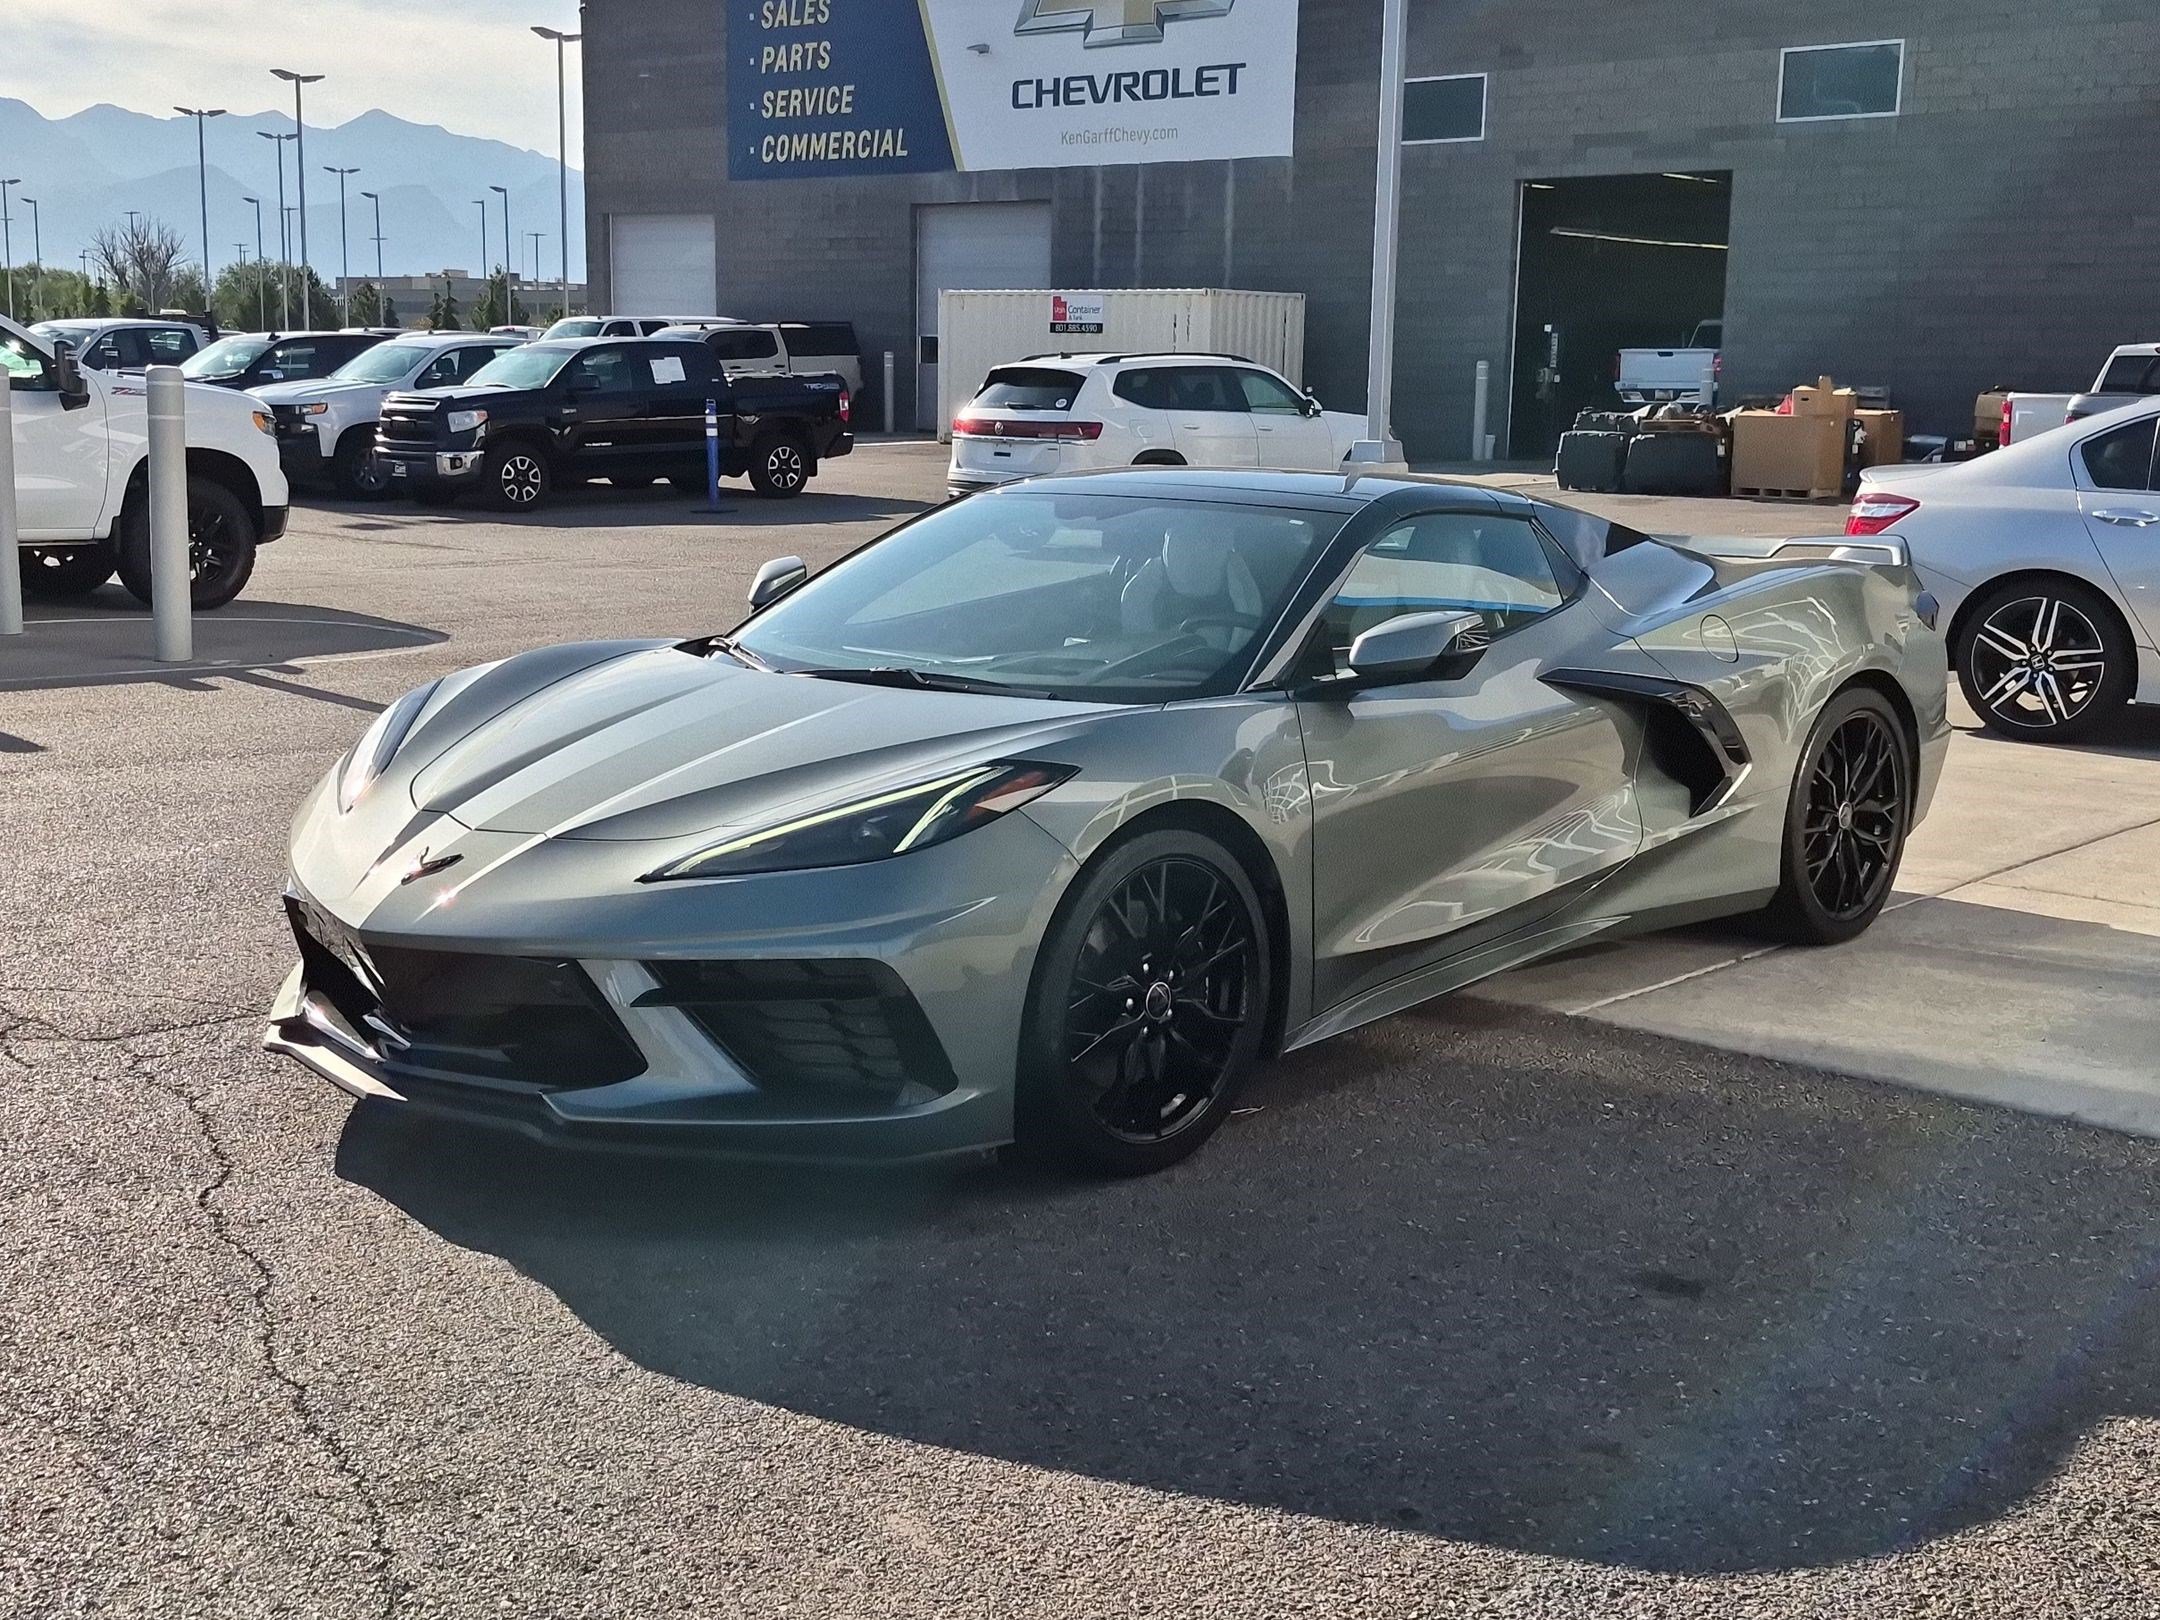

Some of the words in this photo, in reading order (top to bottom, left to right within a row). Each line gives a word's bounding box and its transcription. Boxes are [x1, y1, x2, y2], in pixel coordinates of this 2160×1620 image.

[761, 0, 831, 29] SALES
[761, 41, 832, 74] PARTS
[761, 85, 855, 119] SERVICE
[1012, 62, 1247, 109] CHEVROLET
[761, 128, 908, 163] COMMERCIAL
[1061, 127, 1178, 146] KenGarffChevy.com
[1068, 305, 1101, 314] Container
